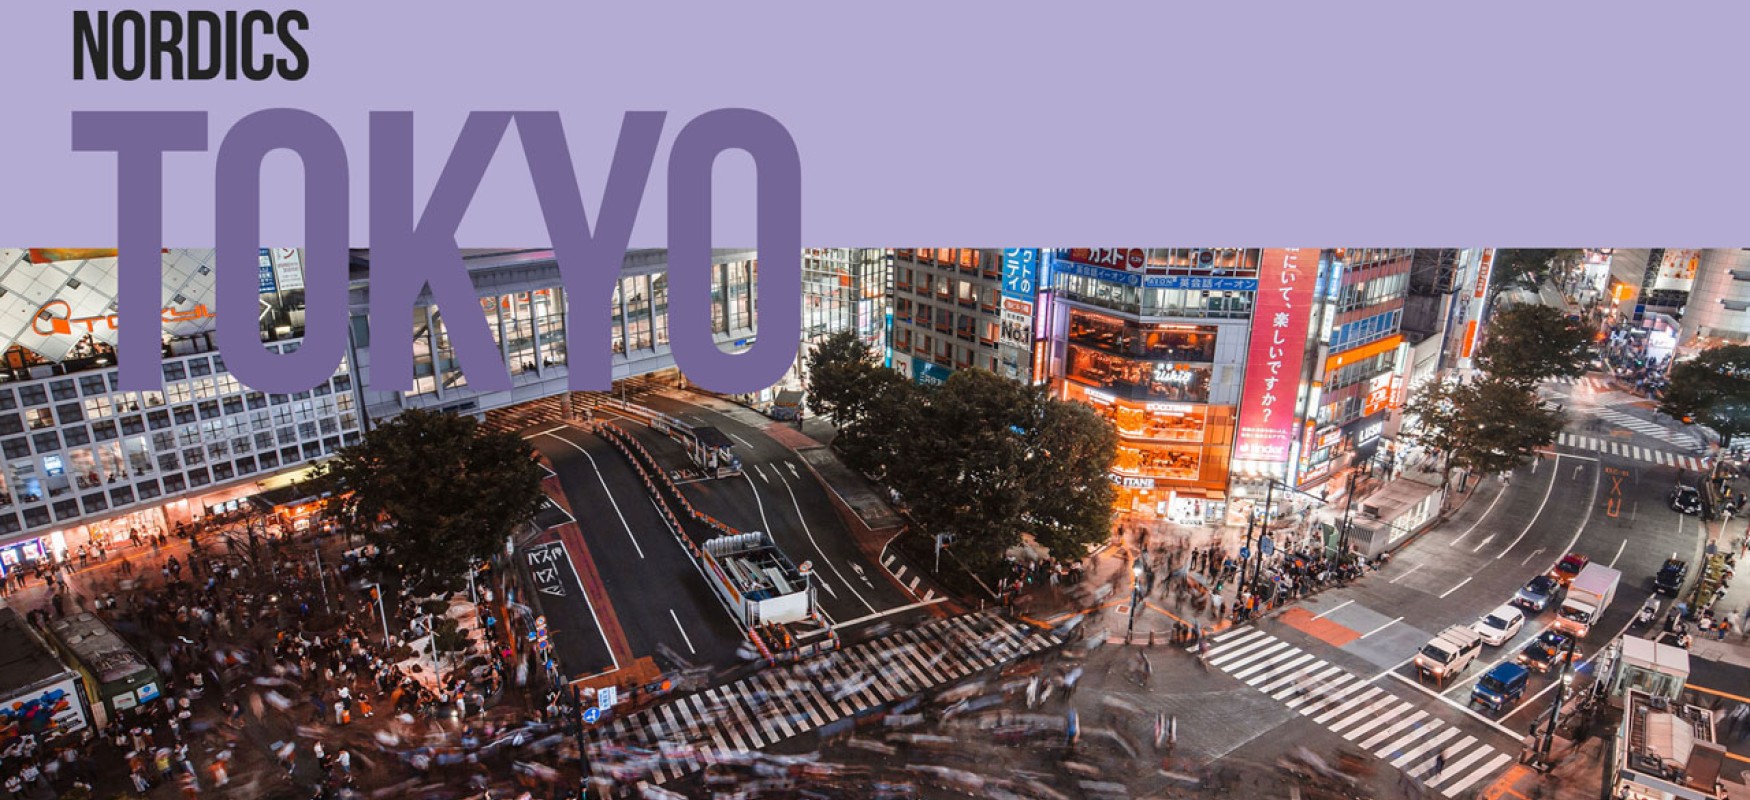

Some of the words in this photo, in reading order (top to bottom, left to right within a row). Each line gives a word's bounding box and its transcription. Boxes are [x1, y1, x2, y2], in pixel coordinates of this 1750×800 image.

[1261, 248, 1300, 422] にいて、楽しいですか？
